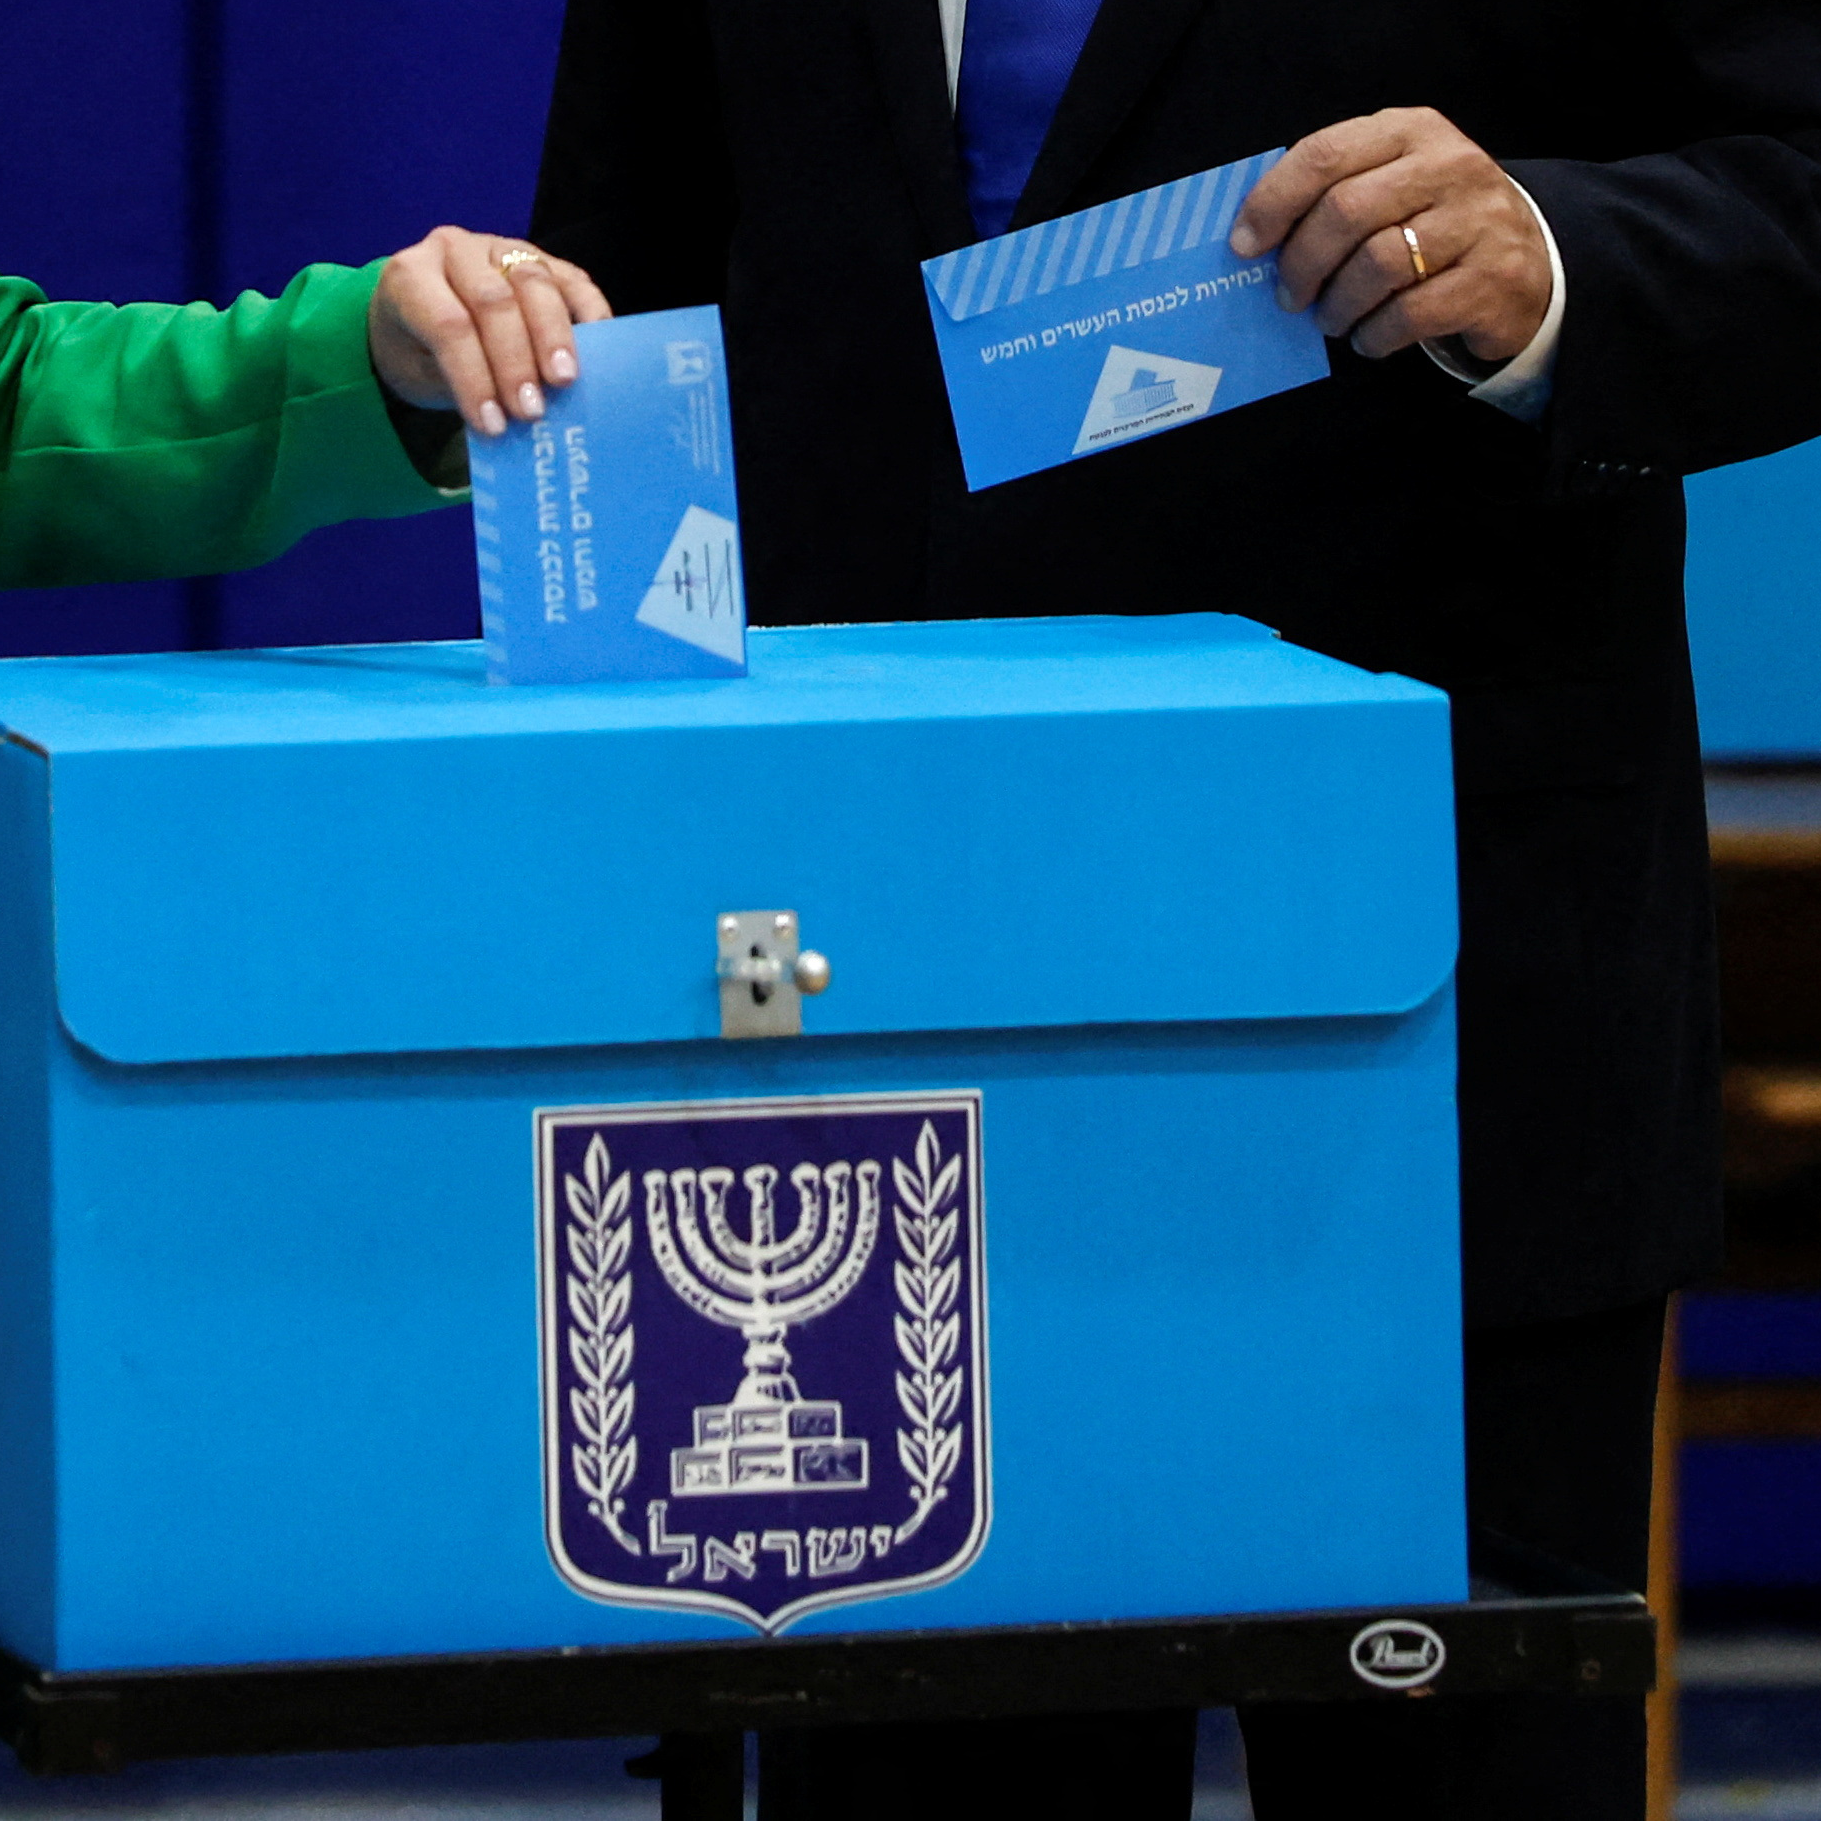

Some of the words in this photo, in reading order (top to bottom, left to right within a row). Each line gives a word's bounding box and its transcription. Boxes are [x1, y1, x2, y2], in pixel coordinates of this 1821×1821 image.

[1041, 308, 1121, 348] העשרים
[1125, 284, 1190, 323] לכנסת
[980, 334, 1038, 365] וחמש
[532, 420, 561, 532] הבחירות
[565, 426, 593, 530] העשרים
[537, 538, 568, 624] לכנסת
[572, 537, 599, 611] וחמש
[646, 1499, 893, 1583] ישראל
